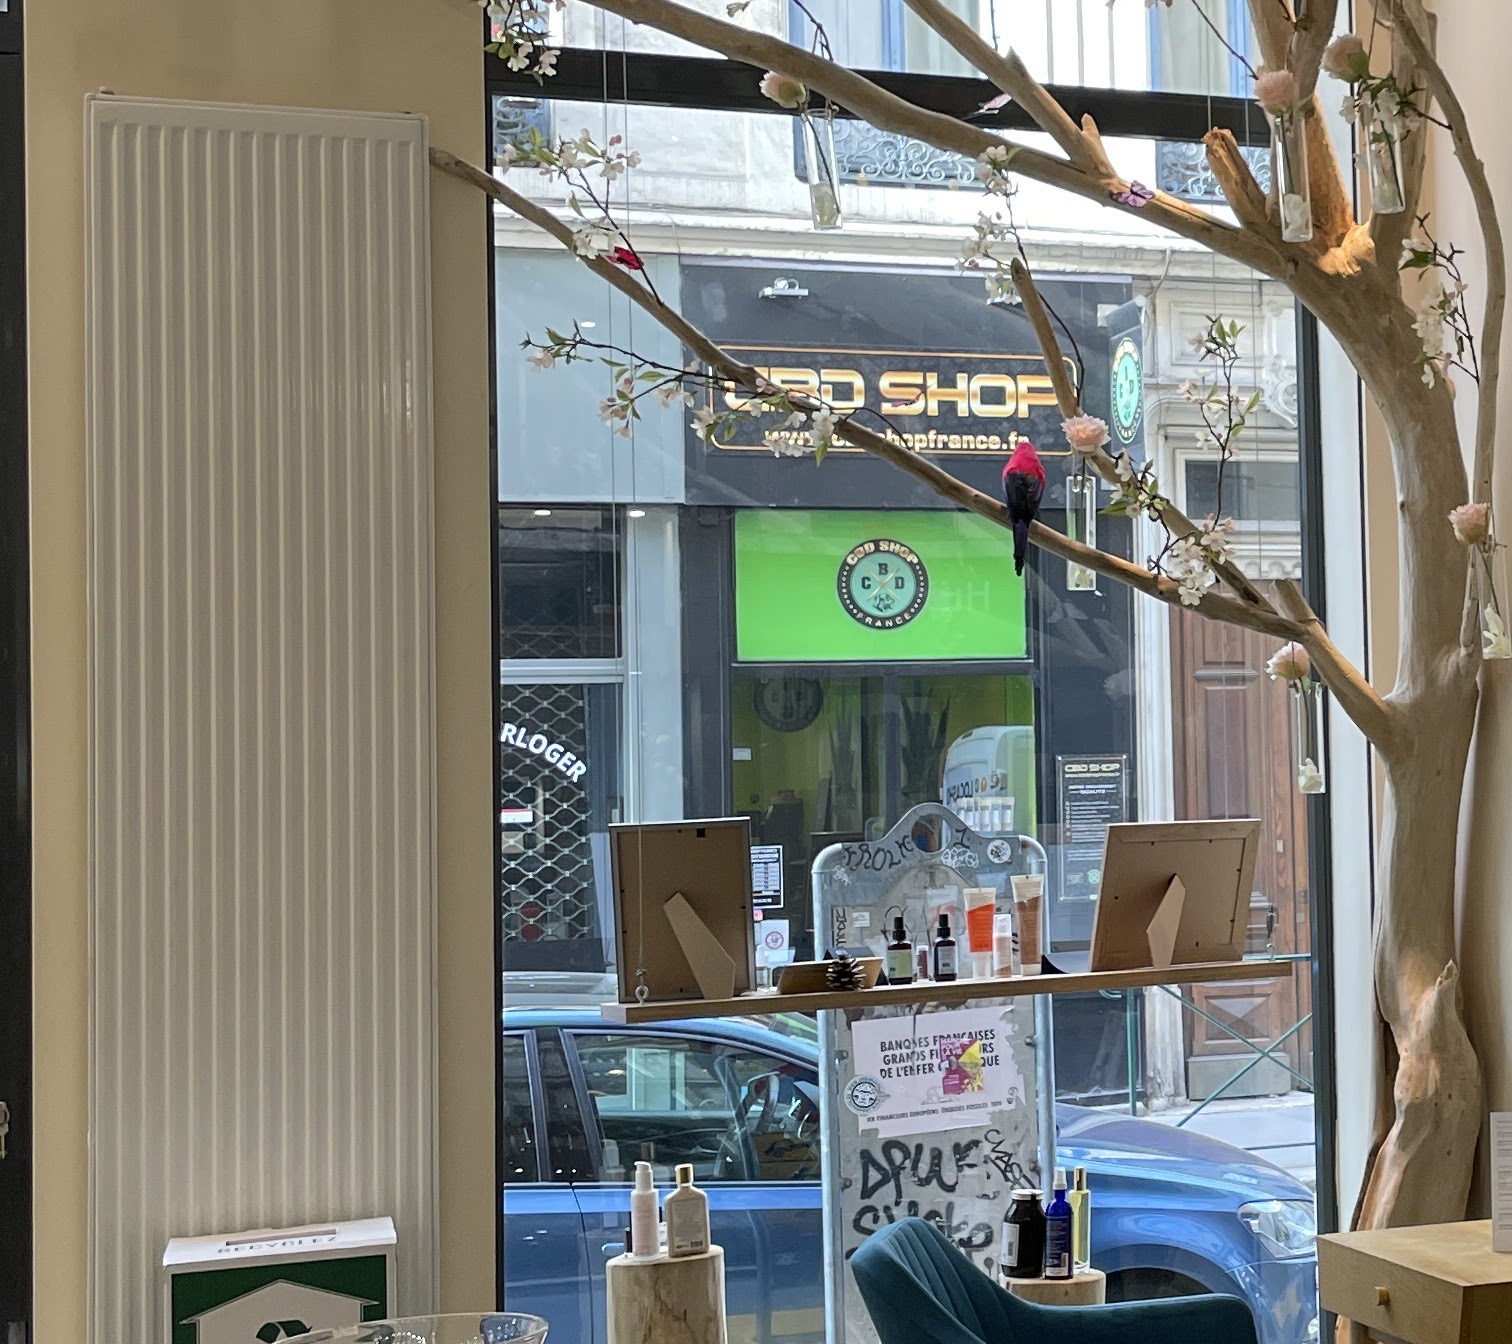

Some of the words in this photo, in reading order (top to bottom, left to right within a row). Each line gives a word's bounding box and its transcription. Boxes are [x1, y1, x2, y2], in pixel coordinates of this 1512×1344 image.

[878, 371, 1060, 420] SHOP
[879, 540, 918, 564] SHOP
[857, 613, 911, 628] FRANCE
[880, 1068, 893, 1079] DE
